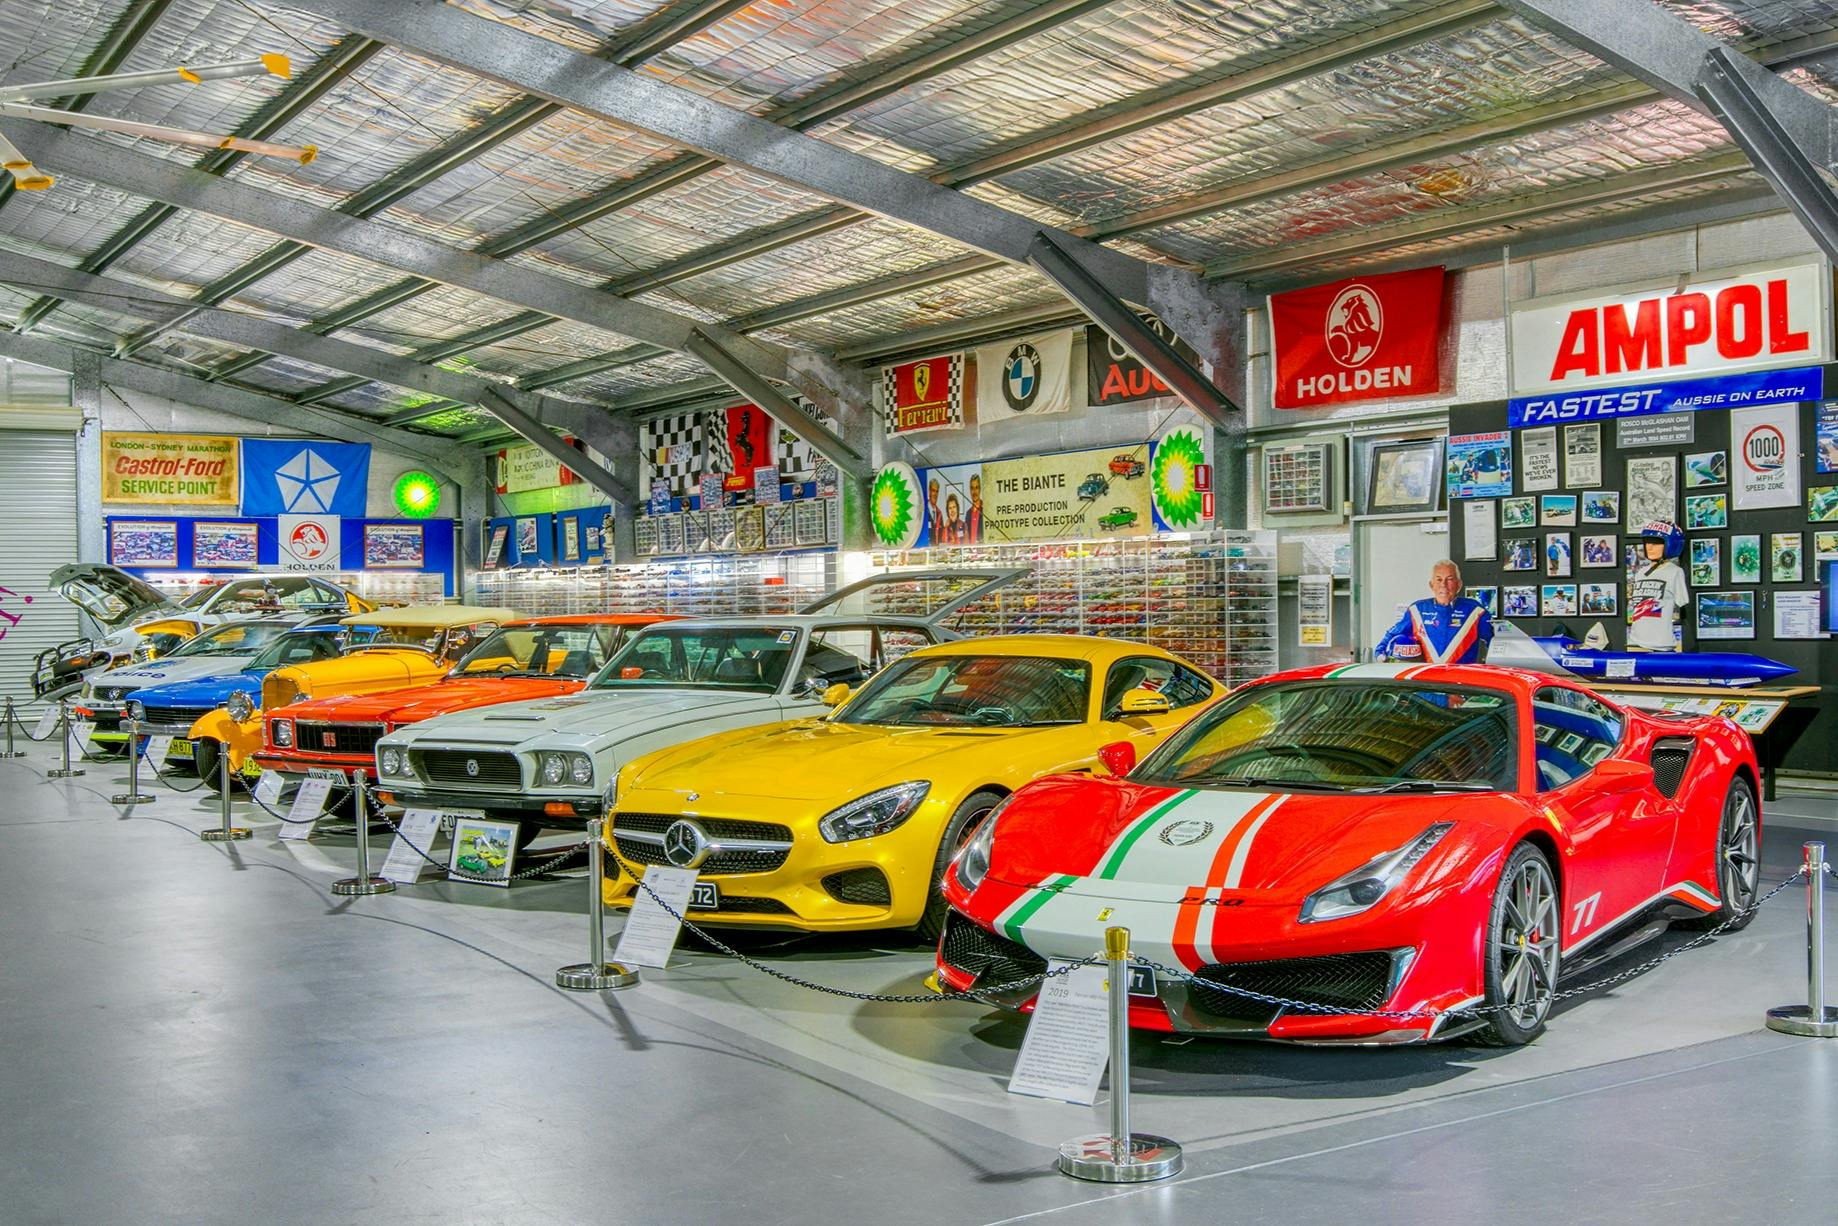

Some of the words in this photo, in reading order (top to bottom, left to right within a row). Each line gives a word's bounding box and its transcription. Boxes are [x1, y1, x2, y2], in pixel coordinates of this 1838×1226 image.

[1549, 279, 1809, 381] AMPOL
[1006, 345, 1040, 370] BMW
[1297, 365, 1412, 399] HOLDEN
[1523, 388, 1662, 422] FASTEST
[1673, 393, 1726, 408] AUSSIE
[1729, 391, 1751, 401] ON
[1755, 386, 1805, 400] EARTH
[898, 401, 947, 428] Ferrari
[1449, 435, 1473, 444] AUSSIE
[1749, 436, 1780, 458] 1000
[187, 445, 232, 453] MARATHON
[115, 456, 226, 476] Castrol-Ford
[121, 479, 174, 494] SERVICE
[177, 481, 217, 495] POINT
[996, 479, 1018, 493] THE
[1022, 473, 1066, 491] BIANTE
[1745, 483, 1766, 492] SPEED
[1767, 482, 1785, 490] ZONE
[996, 500, 1068, 515] PRE-PRODUCTION
[985, 518, 1030, 530] PROTOTYPE
[1032, 514, 1085, 527] COLLECTION
[284, 563, 335, 571] HOLDEN
[1047, 987, 1069, 998] 2019
